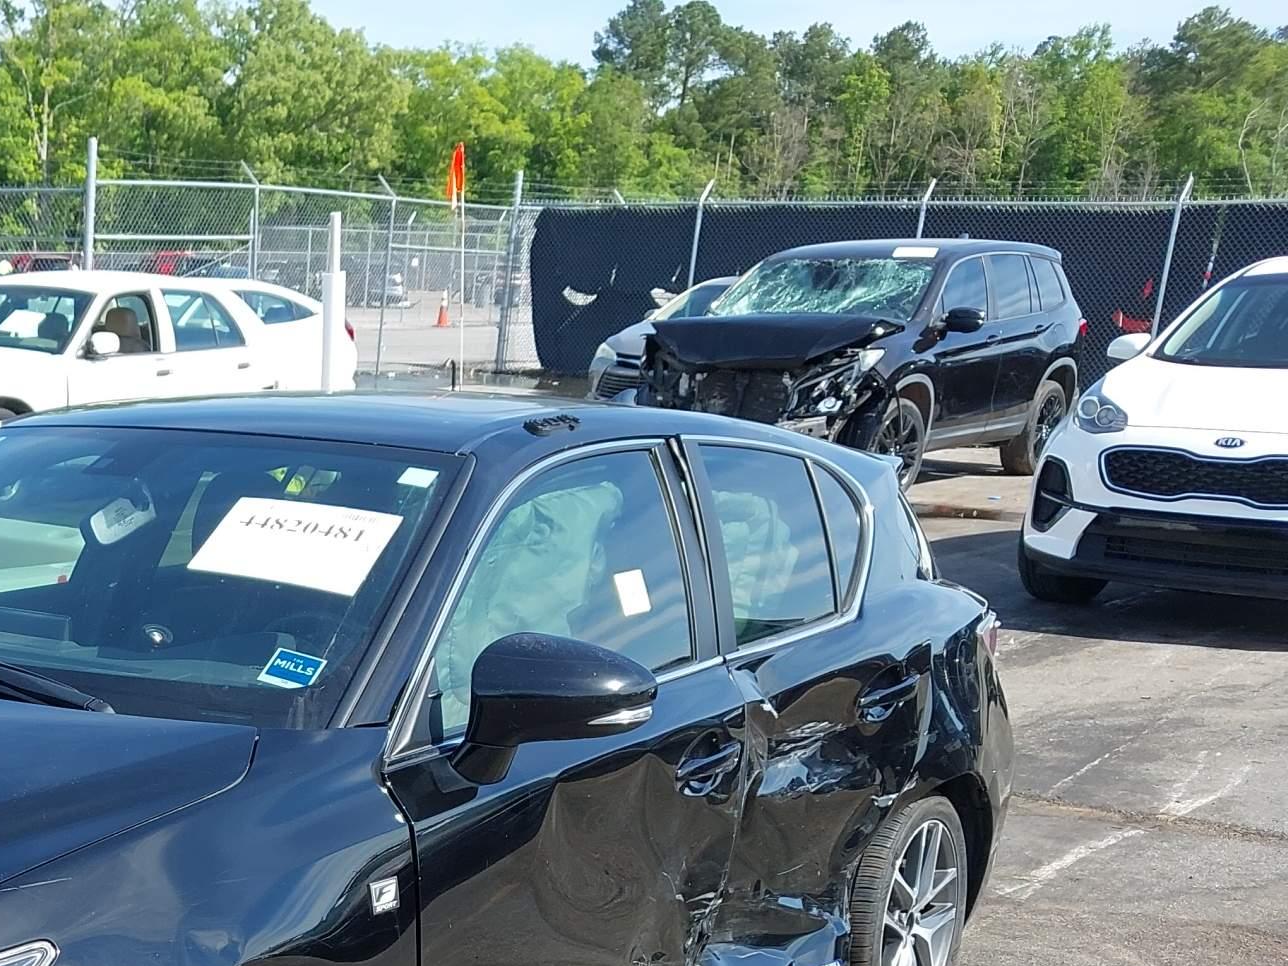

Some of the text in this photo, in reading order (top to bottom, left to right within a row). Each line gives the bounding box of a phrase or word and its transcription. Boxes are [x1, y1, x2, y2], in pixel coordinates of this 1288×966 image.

[1216, 438, 1242, 447] KIA
[239, 514, 366, 542] 44820481
[273, 658, 315, 676] MILLS
